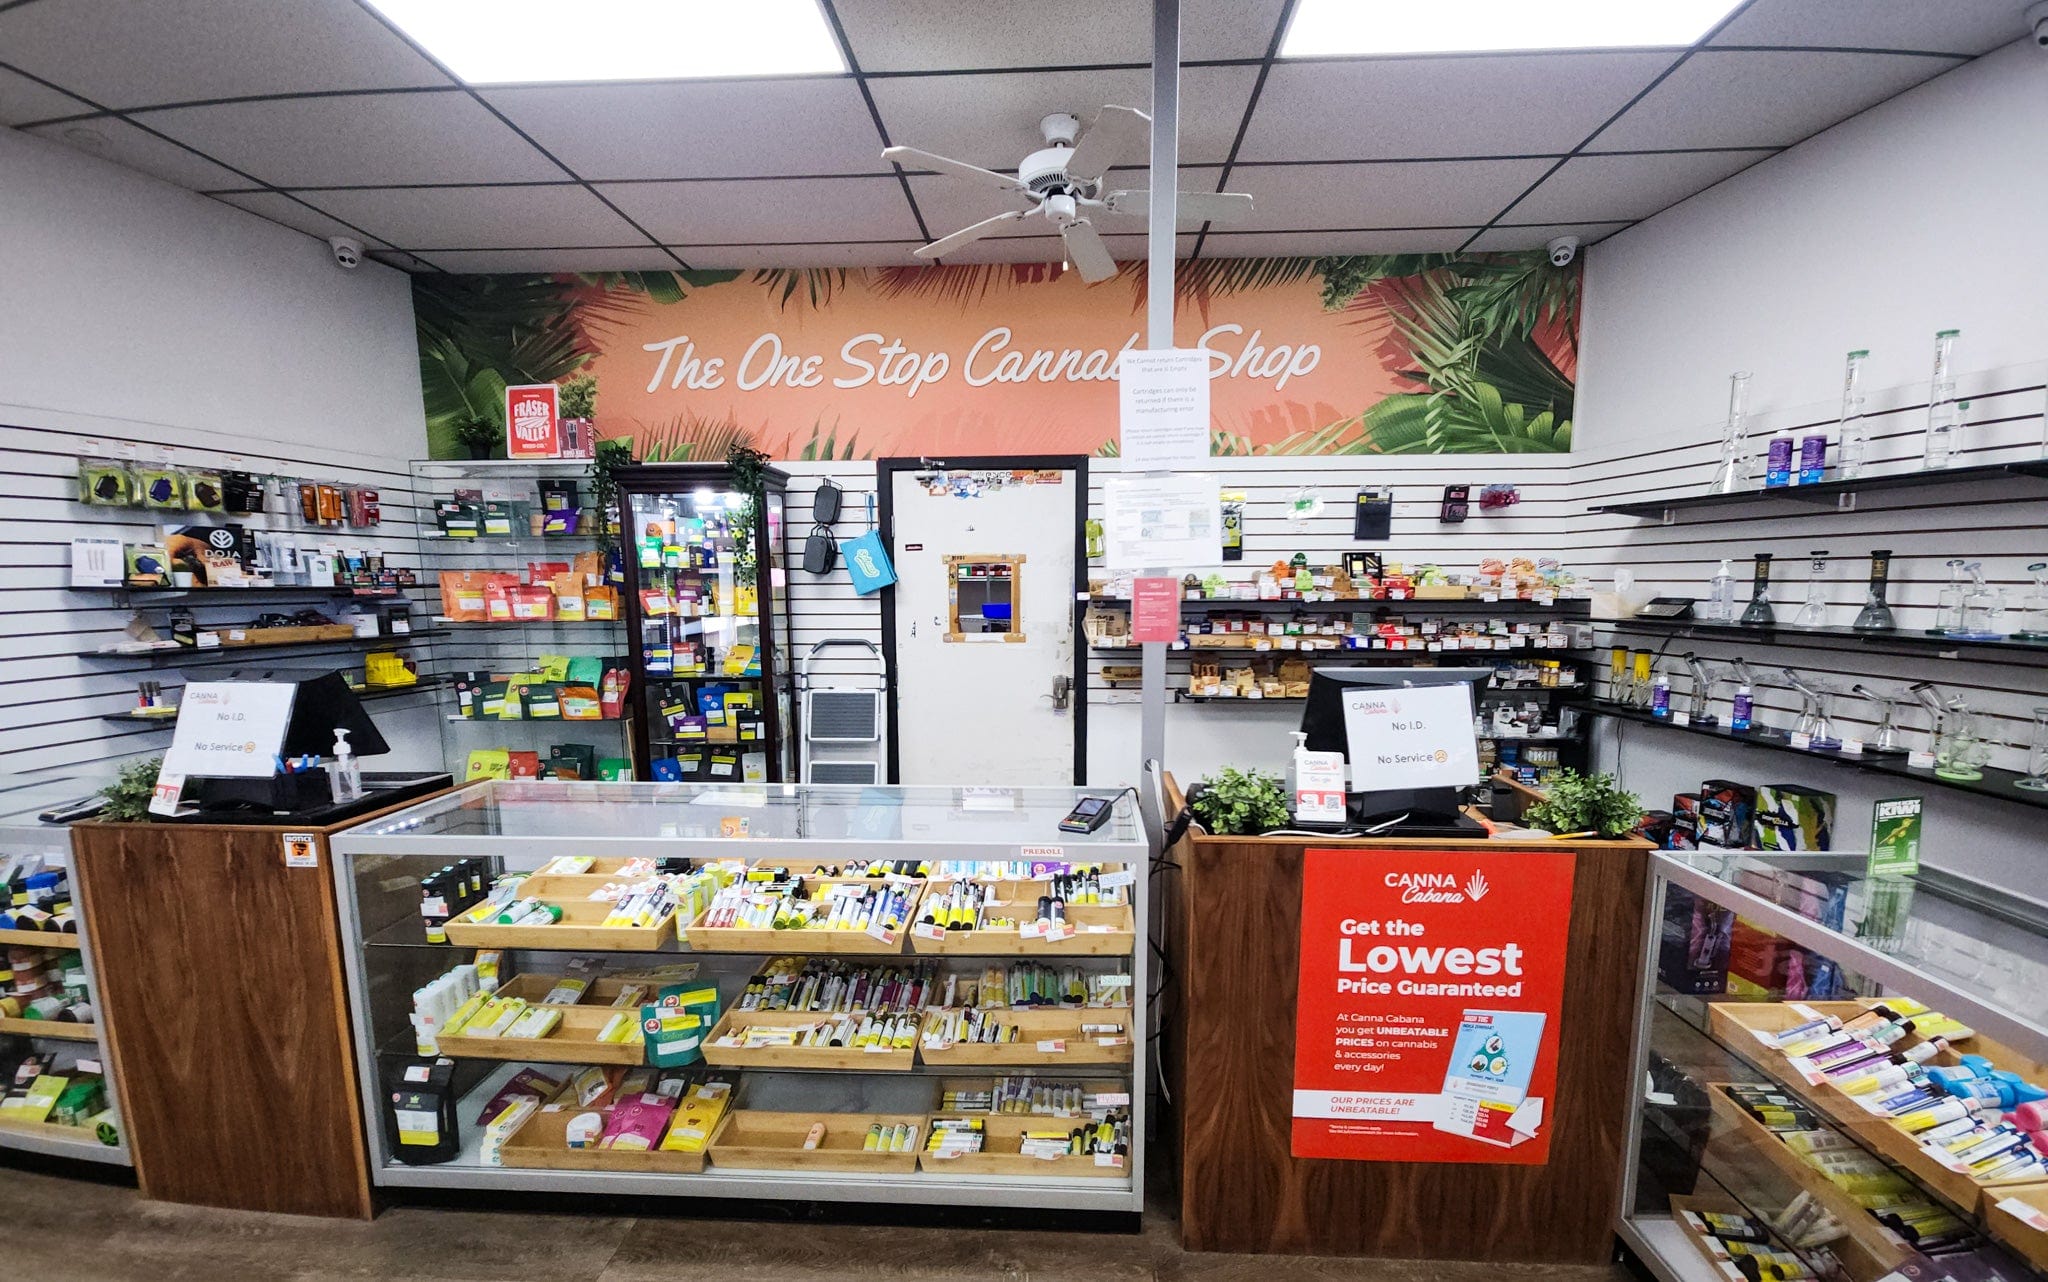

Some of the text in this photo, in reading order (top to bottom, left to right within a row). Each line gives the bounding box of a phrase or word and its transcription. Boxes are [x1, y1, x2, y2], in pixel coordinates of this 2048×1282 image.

[642, 335, 725, 394] The
[736, 332, 824, 391] One
[833, 332, 950, 398] Stop
[1197, 324, 1321, 391] Shop
[1132, 388, 1162, 396] Cartridges
[513, 400, 550, 418] FRASER
[1136, 406, 1178, 415] manufacturing
[515, 423, 551, 442] VALLEY
[204, 549, 242, 559] DOJA
[212, 559, 235, 568] RAW
[190, 692, 218, 700] CANNA
[1351, 701, 1386, 711] CANNA
[216, 712, 247, 722] No I.D.
[1391, 721, 1427, 731] No I.D.
[194, 742, 244, 752] No Service
[1377, 753, 1433, 764] No Service
[1879, 803, 1921, 817] KIWI
[1384, 872, 1457, 889] CANNA
[1402, 884, 1465, 904] Cabana
[1340, 919, 1425, 937] Get the
[1338, 937, 1523, 977] Lowest
[1337, 978, 1392, 995] Price
[1336, 1013, 1425, 1025] At Canna Cabana
[1336, 1026, 1449, 1037] you get UNBEATABLE
[1335, 1037, 1438, 1049] PRICES on cannabis
[1335, 1050, 1401, 1060] & accessories
[1334, 1061, 1385, 1073] every day!
[1331, 1096, 1416, 1107] OUR PRICES ARE
[1330, 1105, 1401, 1115] UNBEATABLE!
